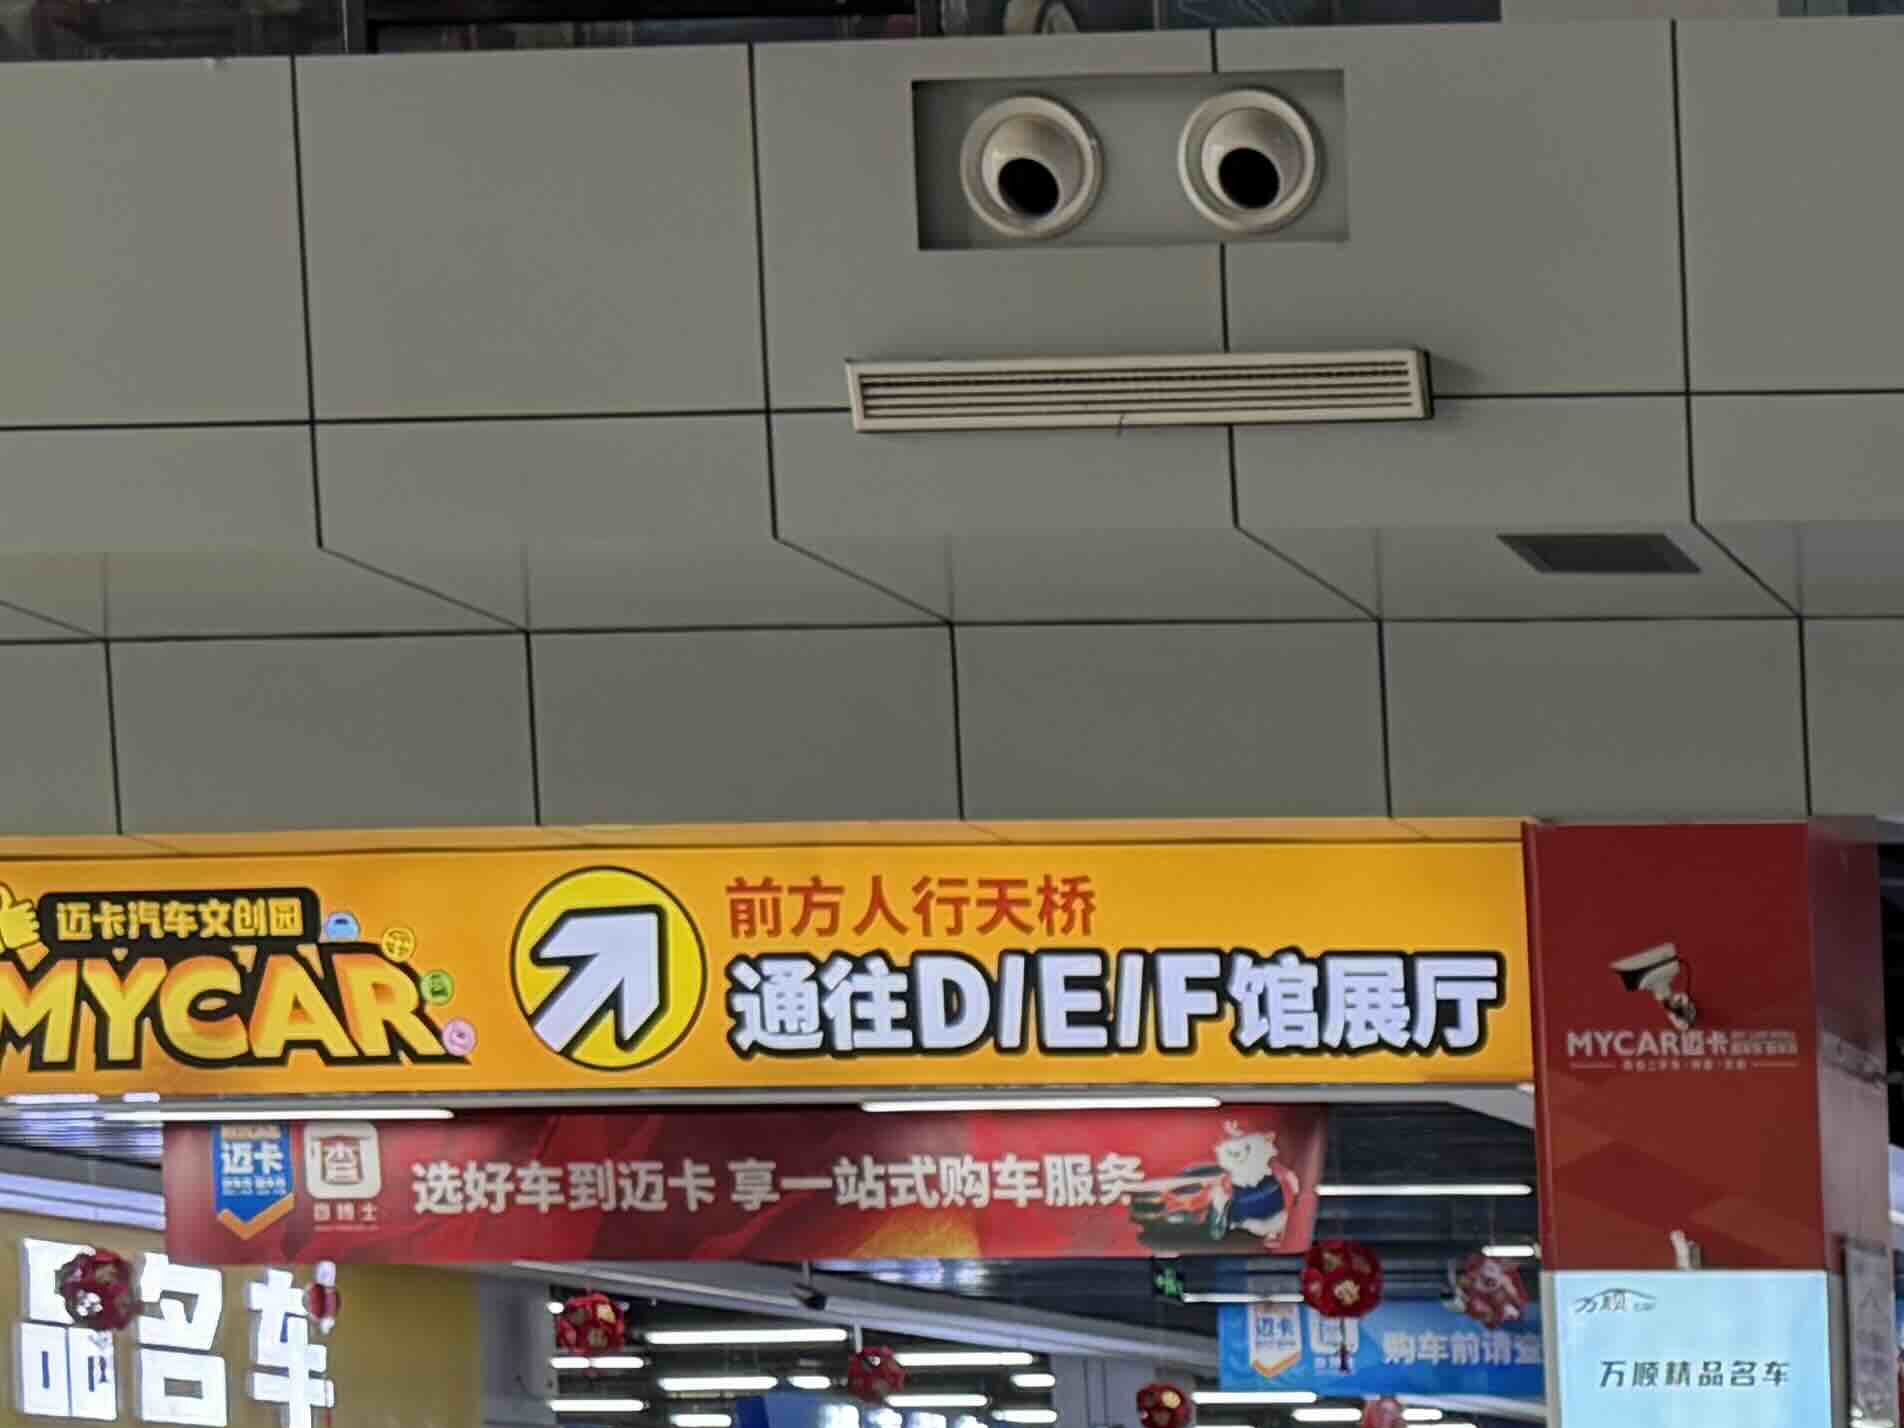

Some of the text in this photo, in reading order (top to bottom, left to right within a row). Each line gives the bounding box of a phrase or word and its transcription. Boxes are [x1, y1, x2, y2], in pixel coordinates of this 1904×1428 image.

[56, 898, 305, 940] 迈卡汽车文创园
[726, 875, 1097, 938] 前方人行天桥
[0, 955, 455, 1065] MYCAR
[221, 1141, 284, 1175] 迈卡
[412, 1153, 1145, 1214] 选好车到迈卡 享一站式购车服务
[1600, 1360, 1790, 1387] 万顺精品名车
